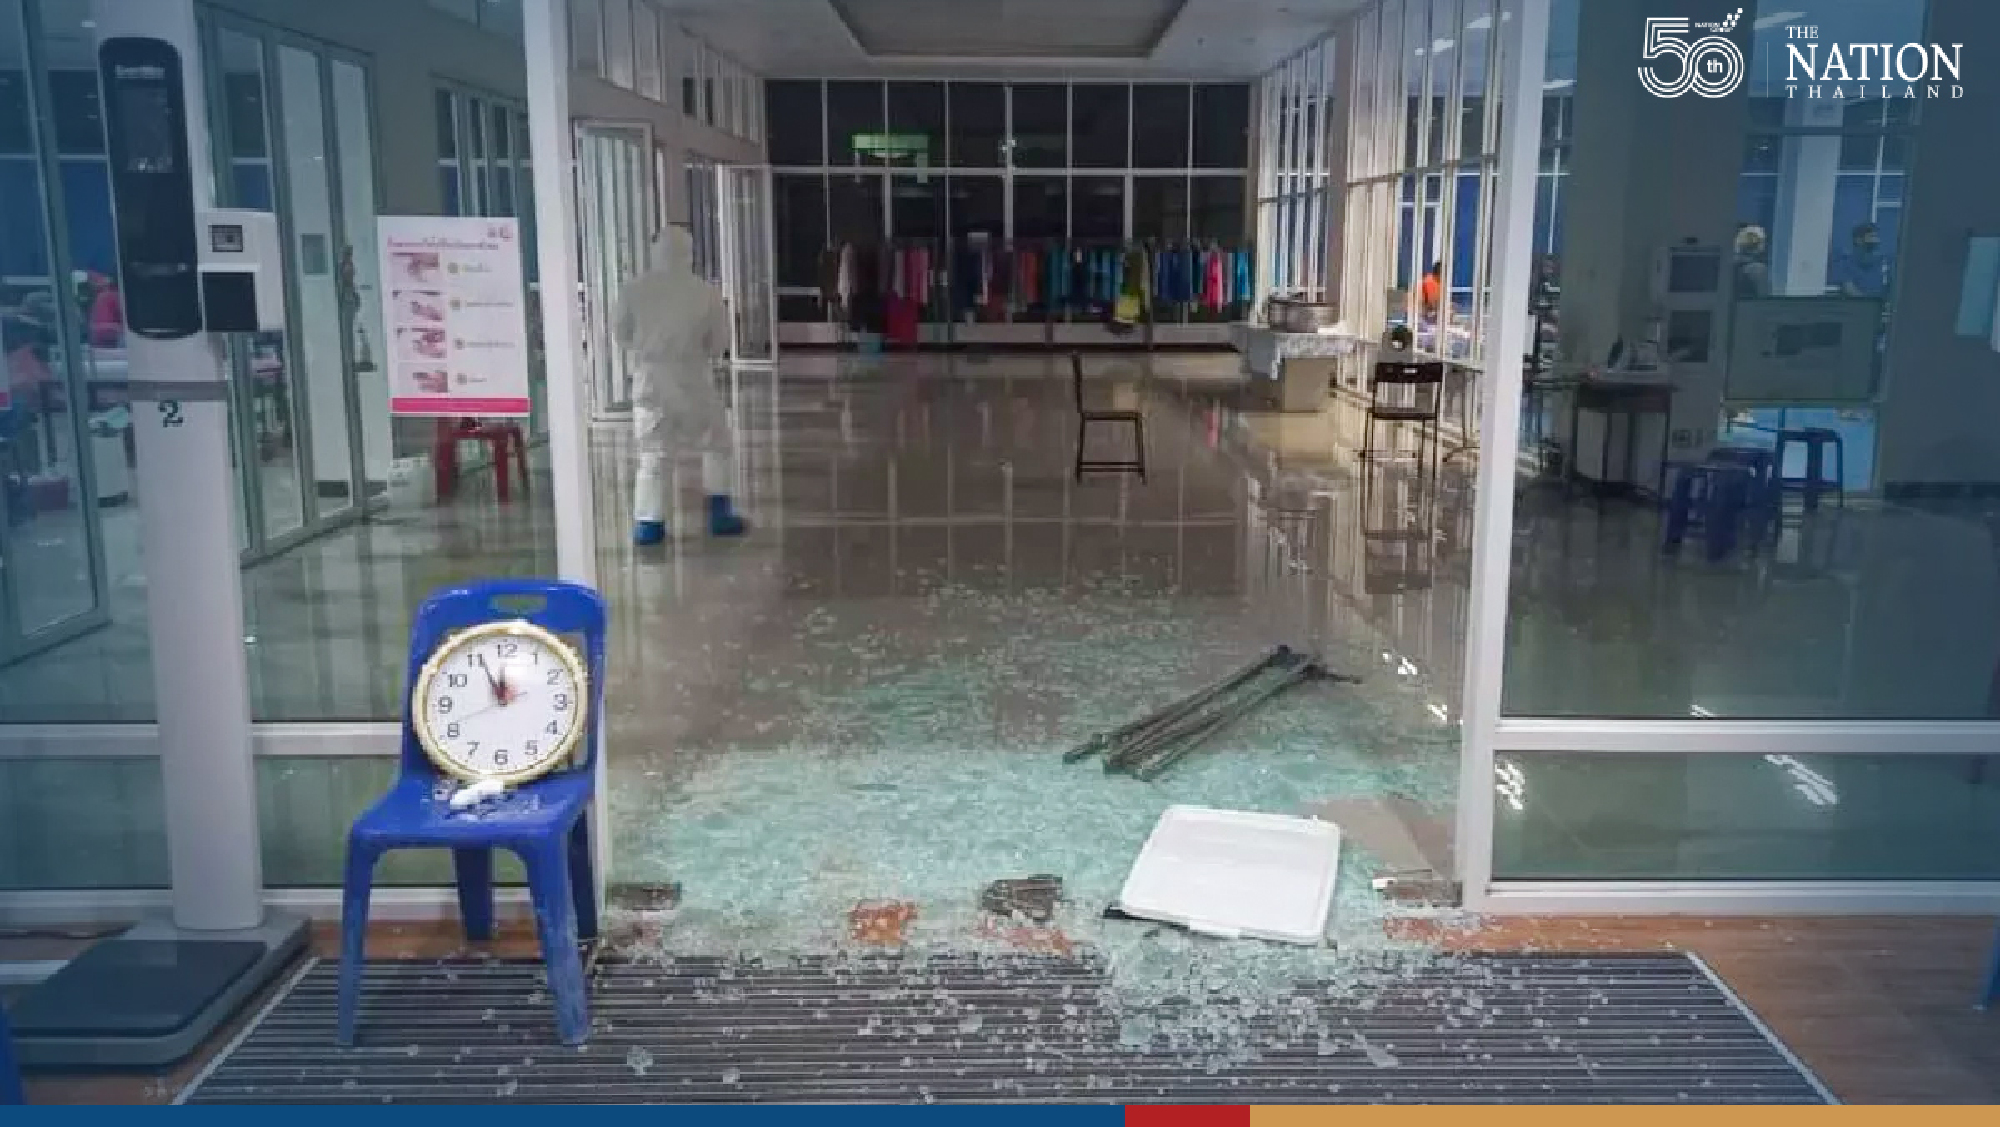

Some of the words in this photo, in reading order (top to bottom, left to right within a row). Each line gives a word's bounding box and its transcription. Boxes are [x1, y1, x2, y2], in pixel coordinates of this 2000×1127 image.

[158, 400, 184, 428] 2
[496, 644, 518, 658] 12
[467, 653, 485, 668] 11
[531, 653, 539, 666] 1
[447, 673, 468, 688] 10
[547, 669, 563, 685] 2
[438, 695, 453, 714] 9
[554, 693, 568, 711] 3
[447, 722, 460, 738] 8
[546, 719, 558, 735] 4
[467, 741, 480, 756] 7
[525, 740, 538, 756] 5
[494, 749, 508, 766] 6
